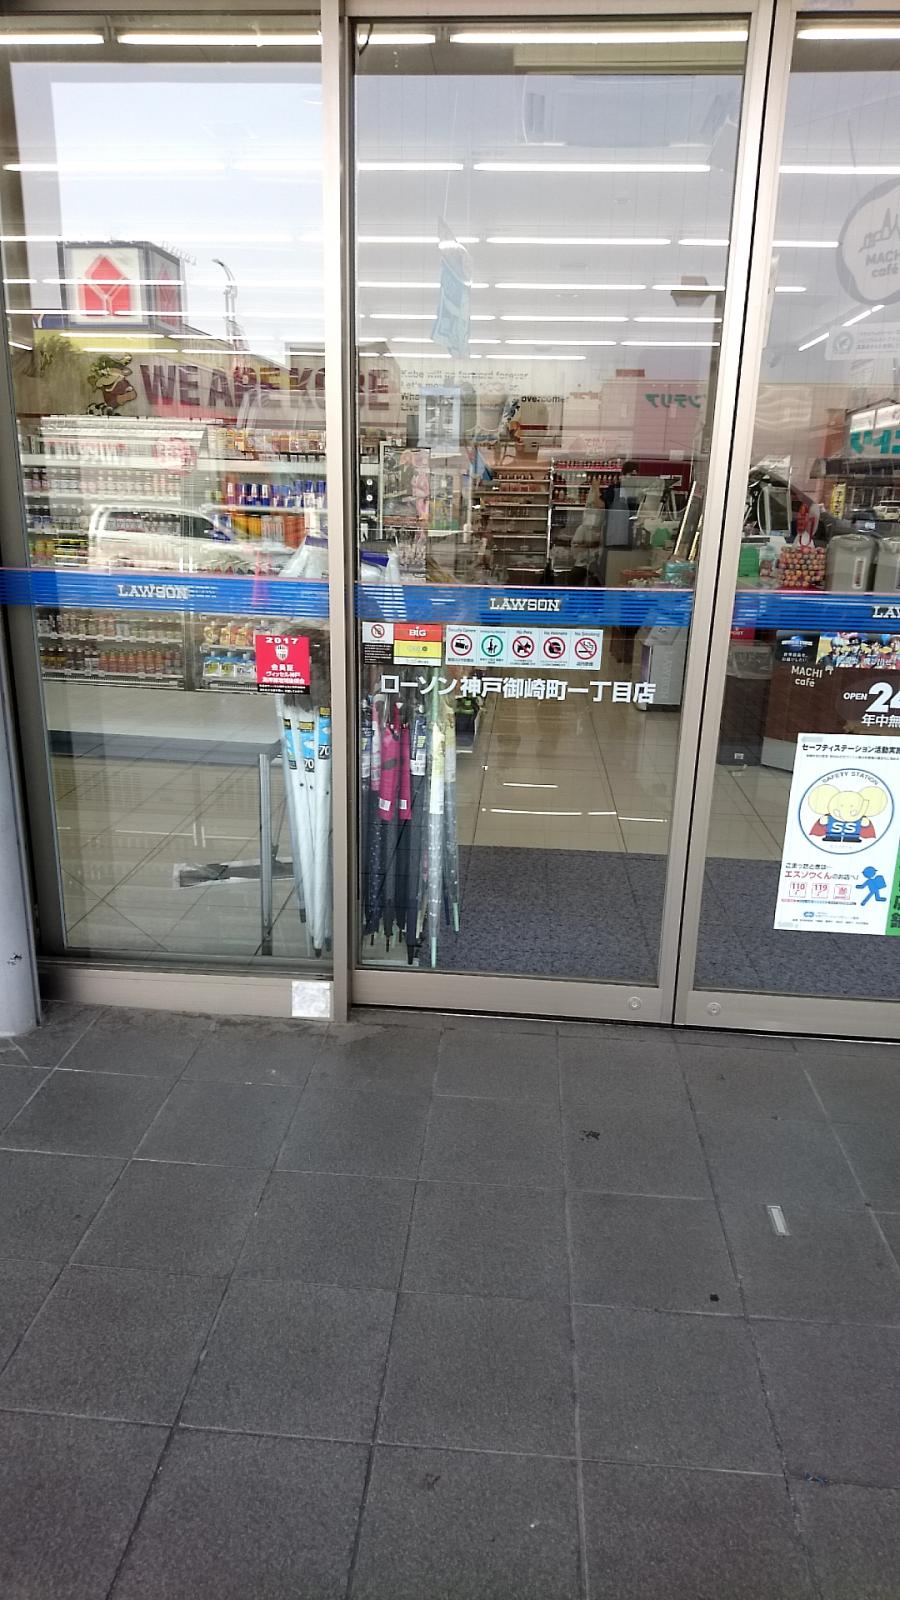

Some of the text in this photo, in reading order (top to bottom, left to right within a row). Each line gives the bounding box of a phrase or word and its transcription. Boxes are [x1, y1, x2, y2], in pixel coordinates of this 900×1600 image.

[139, 364, 200, 406] WE
[117, 584, 189, 599] LAWSON
[490, 597, 560, 611] LAWSON
[872, 605, 900, 619] LA
[265, 636, 299, 644] 2017
[791, 665, 823, 678] MACHI
[380, 674, 657, 703] ローソン 神戸御崎町一丁目店
[795, 677, 815, 687] café
[843, 692, 868, 701] OPEN
[792, 882, 805, 890] 110
[814, 884, 828, 892] 119
